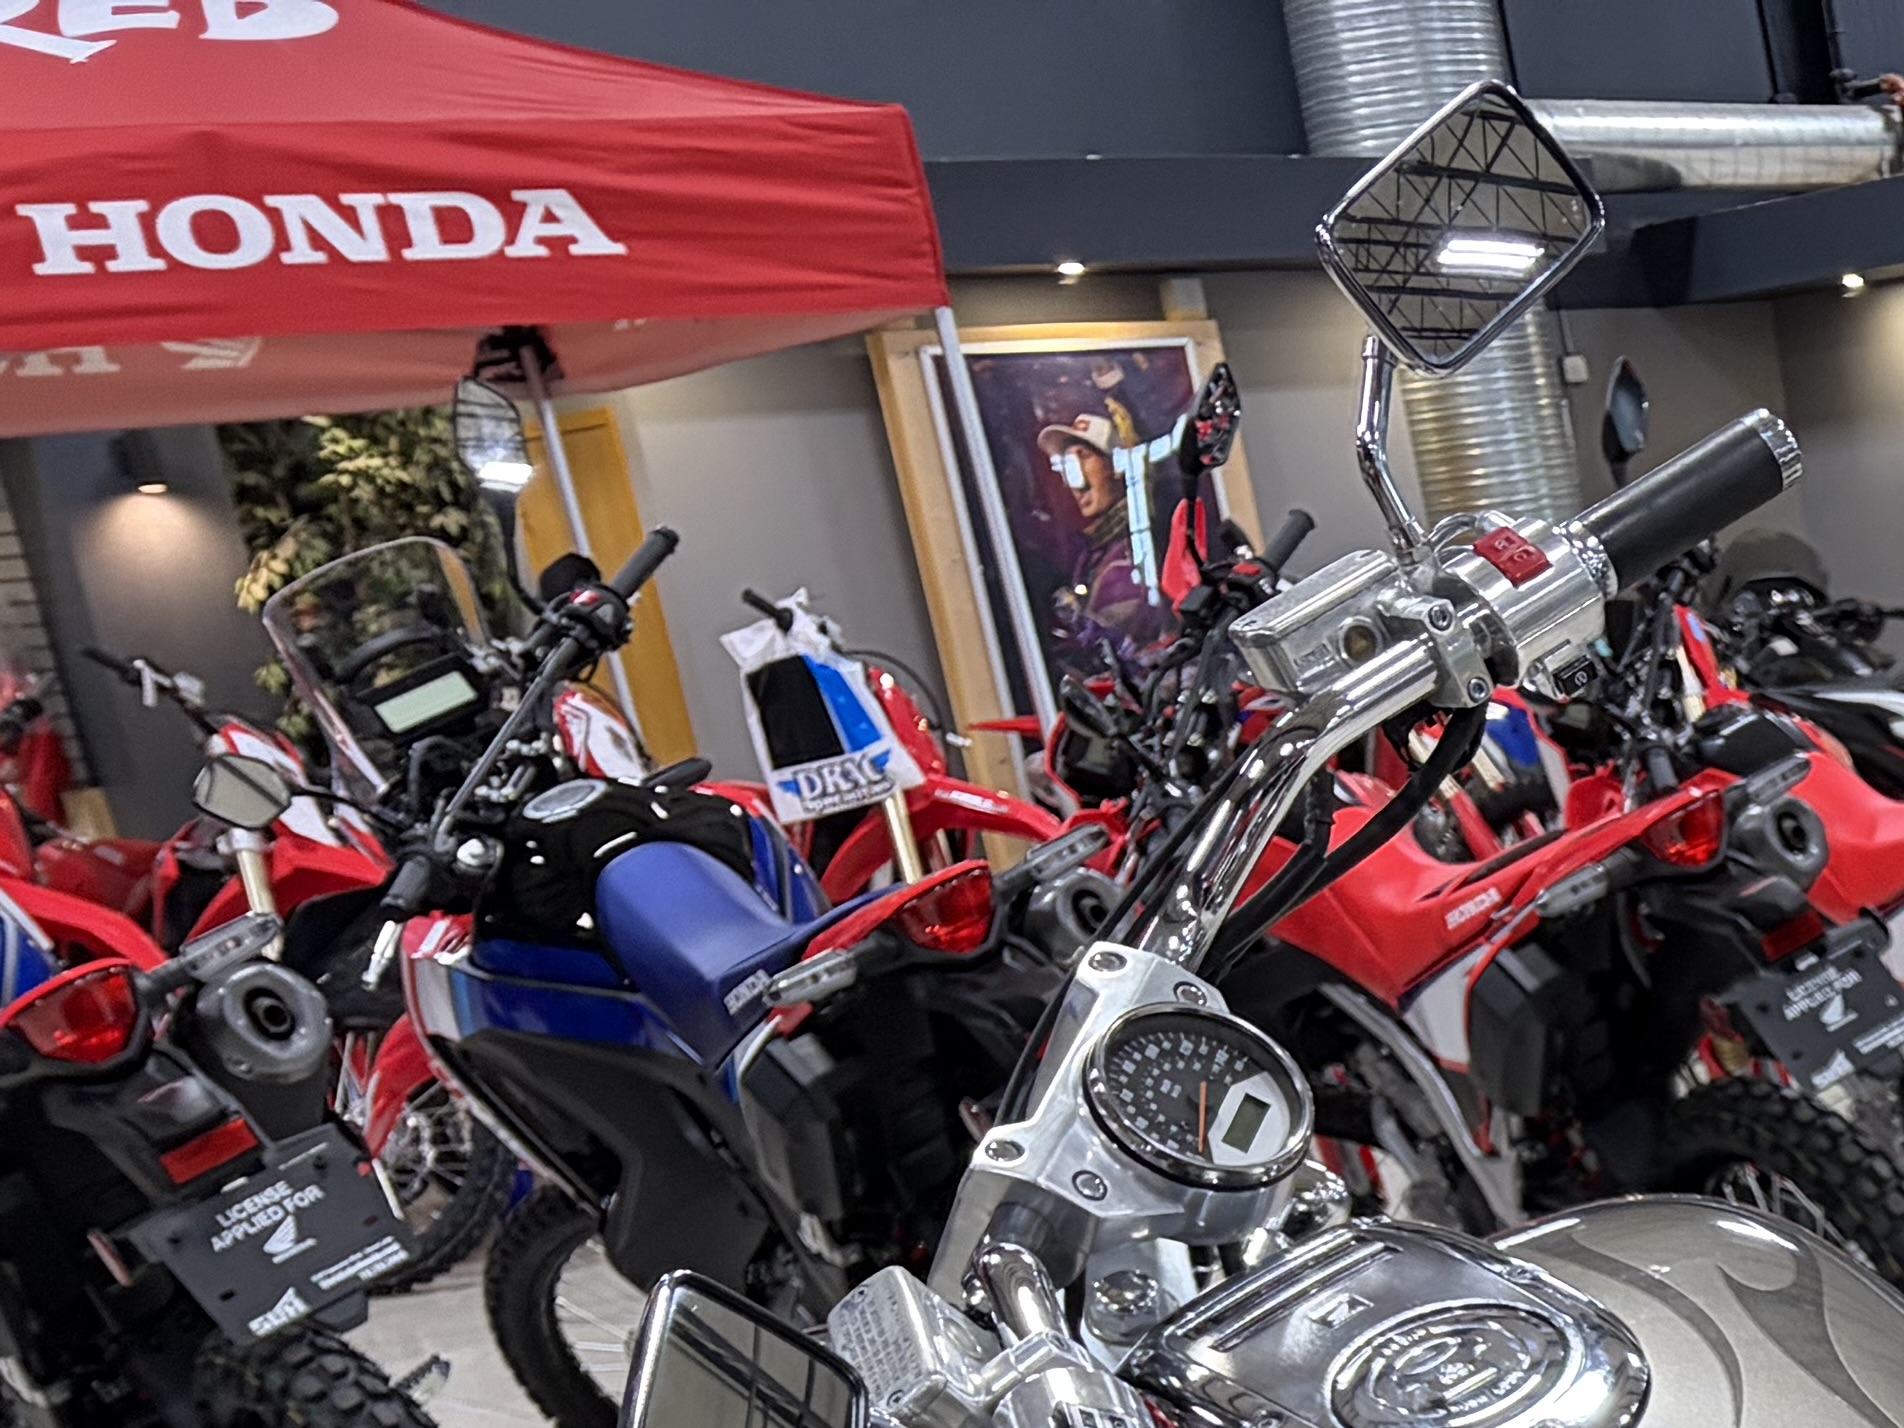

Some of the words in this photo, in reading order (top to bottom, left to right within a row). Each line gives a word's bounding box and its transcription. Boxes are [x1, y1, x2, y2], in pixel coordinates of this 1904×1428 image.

[16, 189, 627, 275] HONDA
[210, 1204, 286, 1252] APPLIED
[282, 1184, 326, 1213] FOR
[215, 1180, 294, 1227] LICENSE
